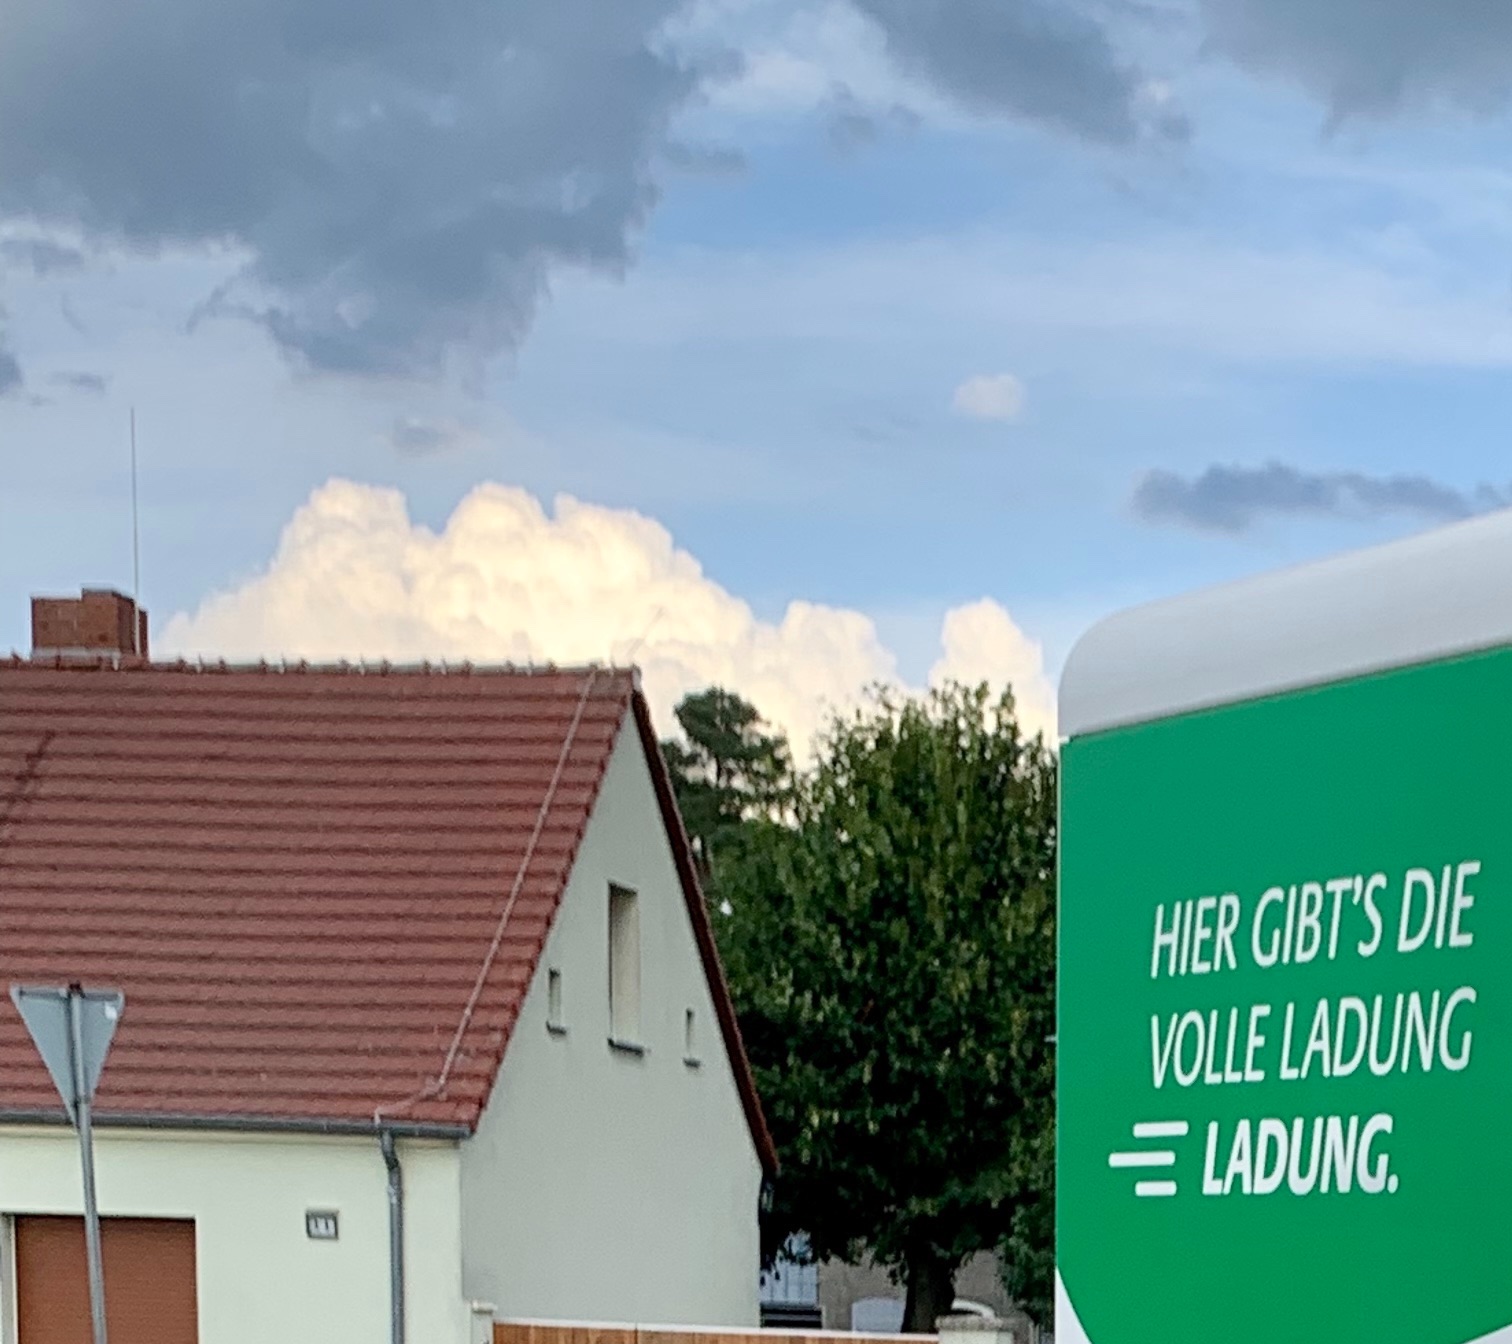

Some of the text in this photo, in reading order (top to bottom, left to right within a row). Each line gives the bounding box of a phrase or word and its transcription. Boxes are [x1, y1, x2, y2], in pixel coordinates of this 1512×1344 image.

[1150, 859, 1482, 980] HIER GIBT'S DIE
[1150, 985, 1477, 1090] VOLLE LADUNG
[1201, 1112, 1400, 1196] LADUNG.
